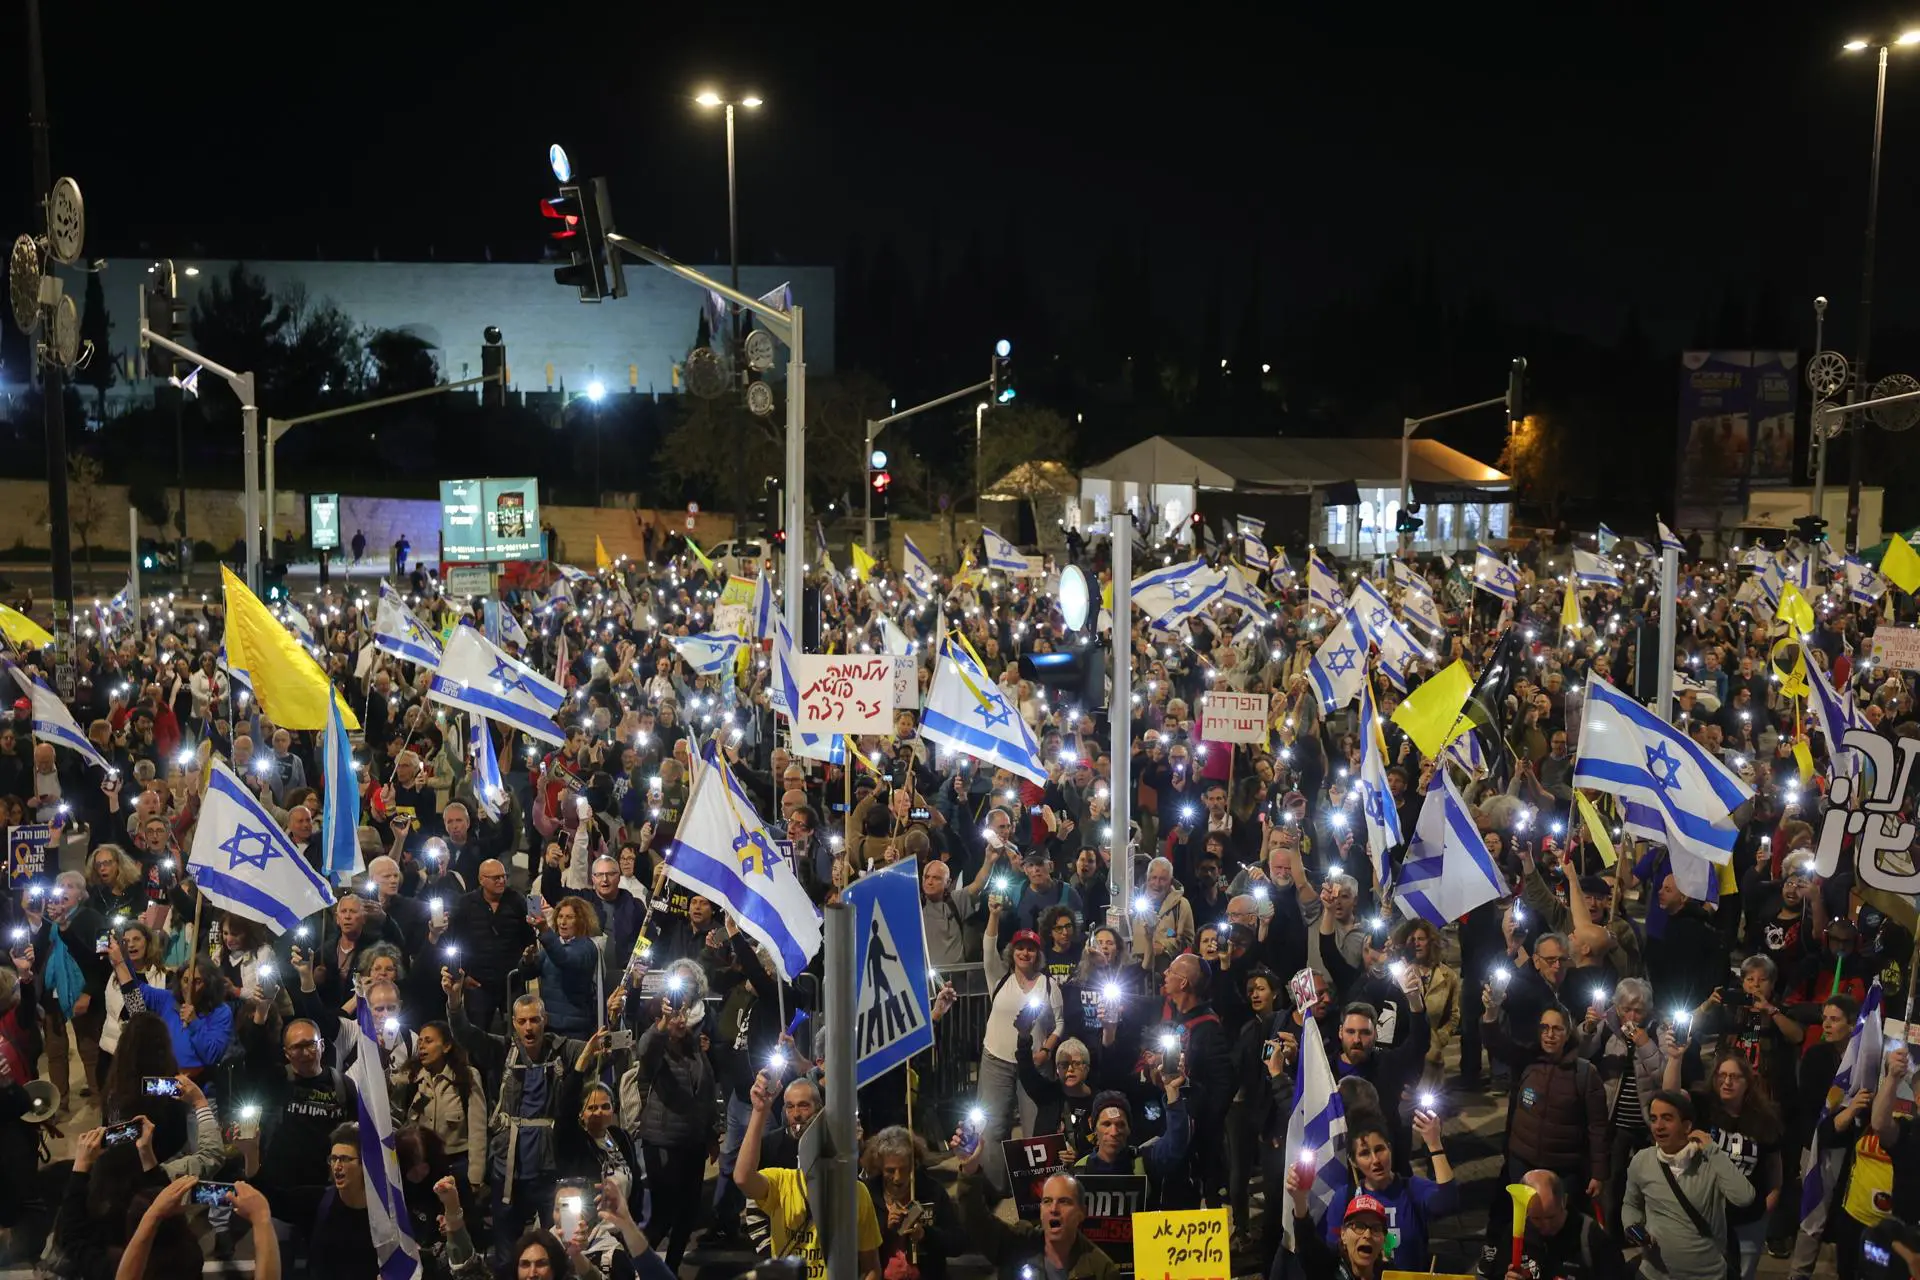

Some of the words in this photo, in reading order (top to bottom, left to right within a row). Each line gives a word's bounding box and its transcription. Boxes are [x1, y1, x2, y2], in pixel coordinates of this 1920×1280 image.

[826, 659, 889, 681] מלחמה
[808, 696, 844, 721] רצח
[856, 700, 881, 719] זה
[1206, 695, 1262, 711] הפרדת
[1205, 718, 1265, 732] רשויות
[1024, 1144, 1047, 1167] כן
[1153, 1219, 1173, 1239] את
[1176, 1220, 1221, 1244] חיבקת
[1167, 1236, 1223, 1266] הילדים?
